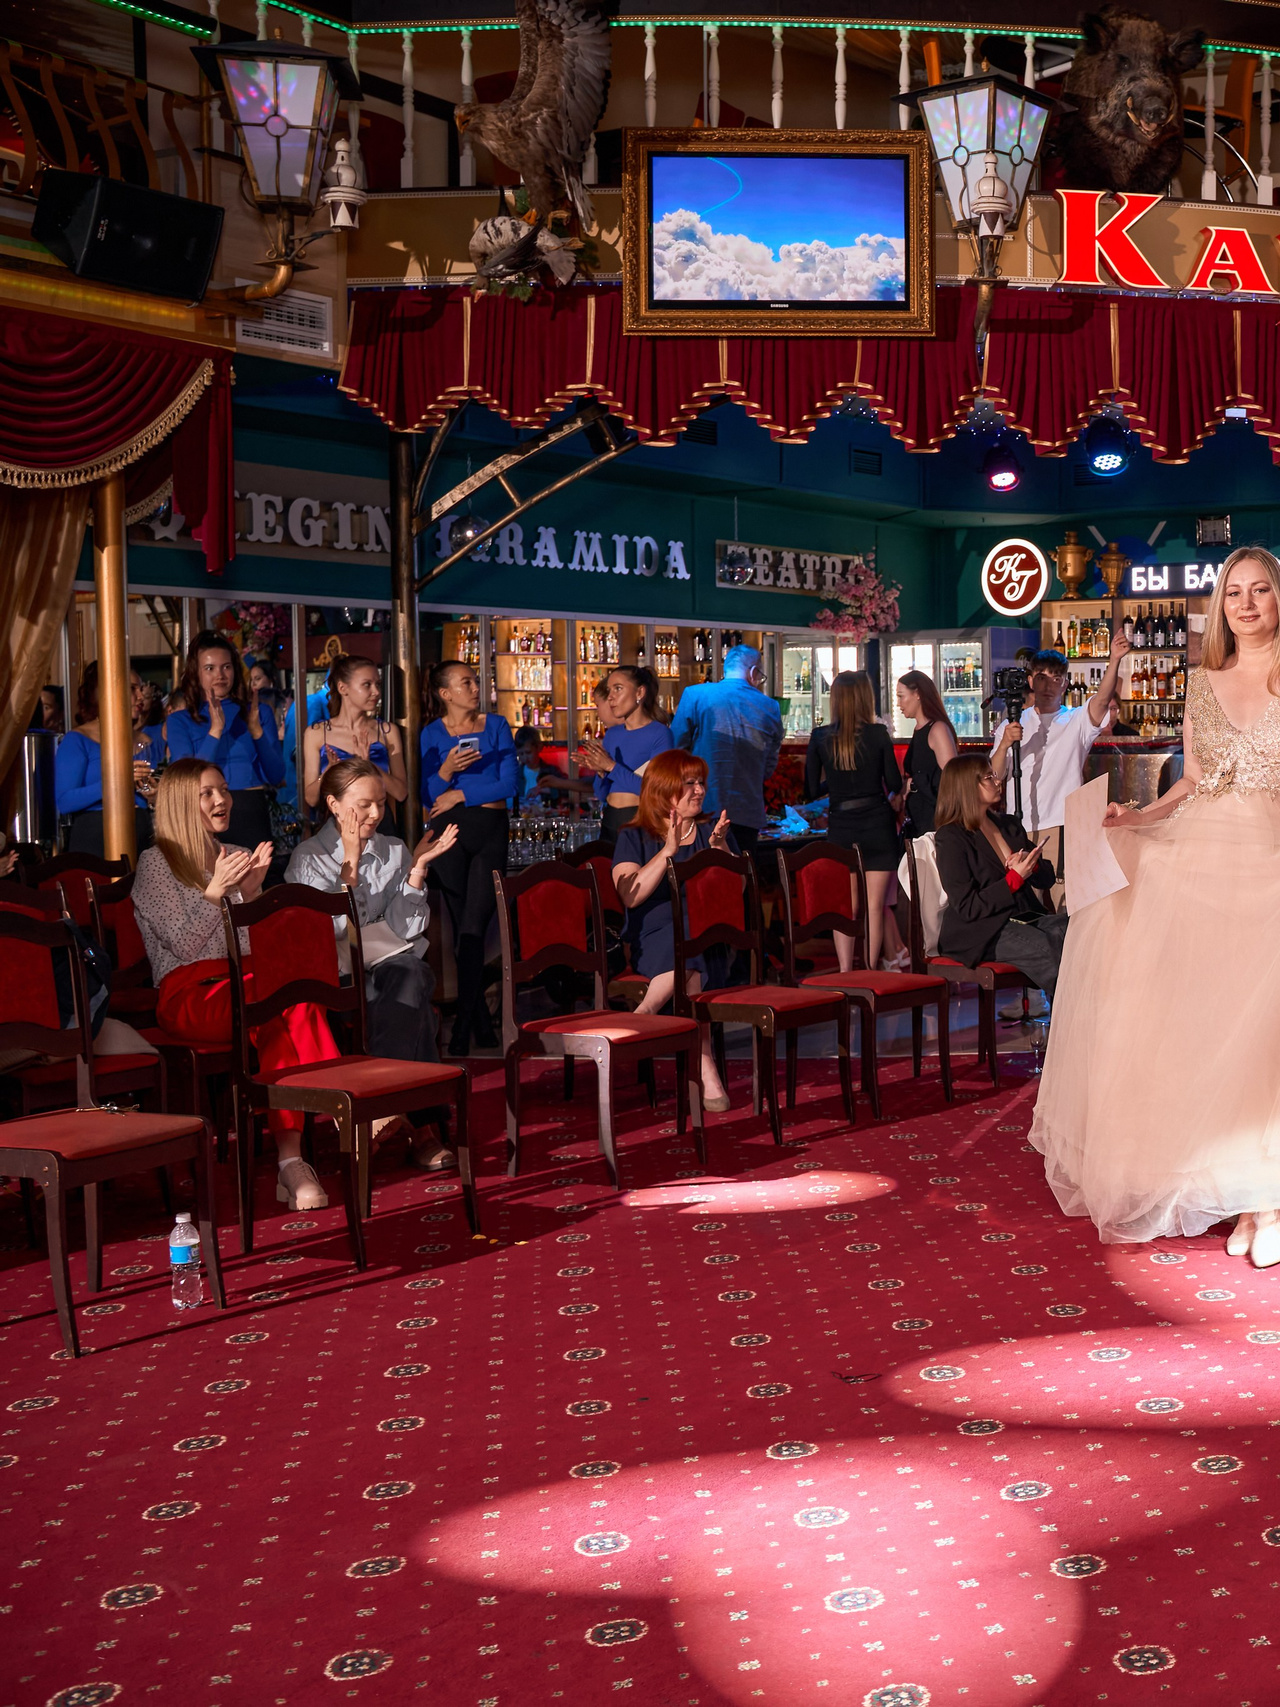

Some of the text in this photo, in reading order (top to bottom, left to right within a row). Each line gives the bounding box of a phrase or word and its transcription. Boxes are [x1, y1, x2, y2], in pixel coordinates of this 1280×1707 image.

[234, 490, 391, 552] EGIN
[435, 514, 691, 580] RAMIDA
[1131, 565, 1169, 592] БЫ
